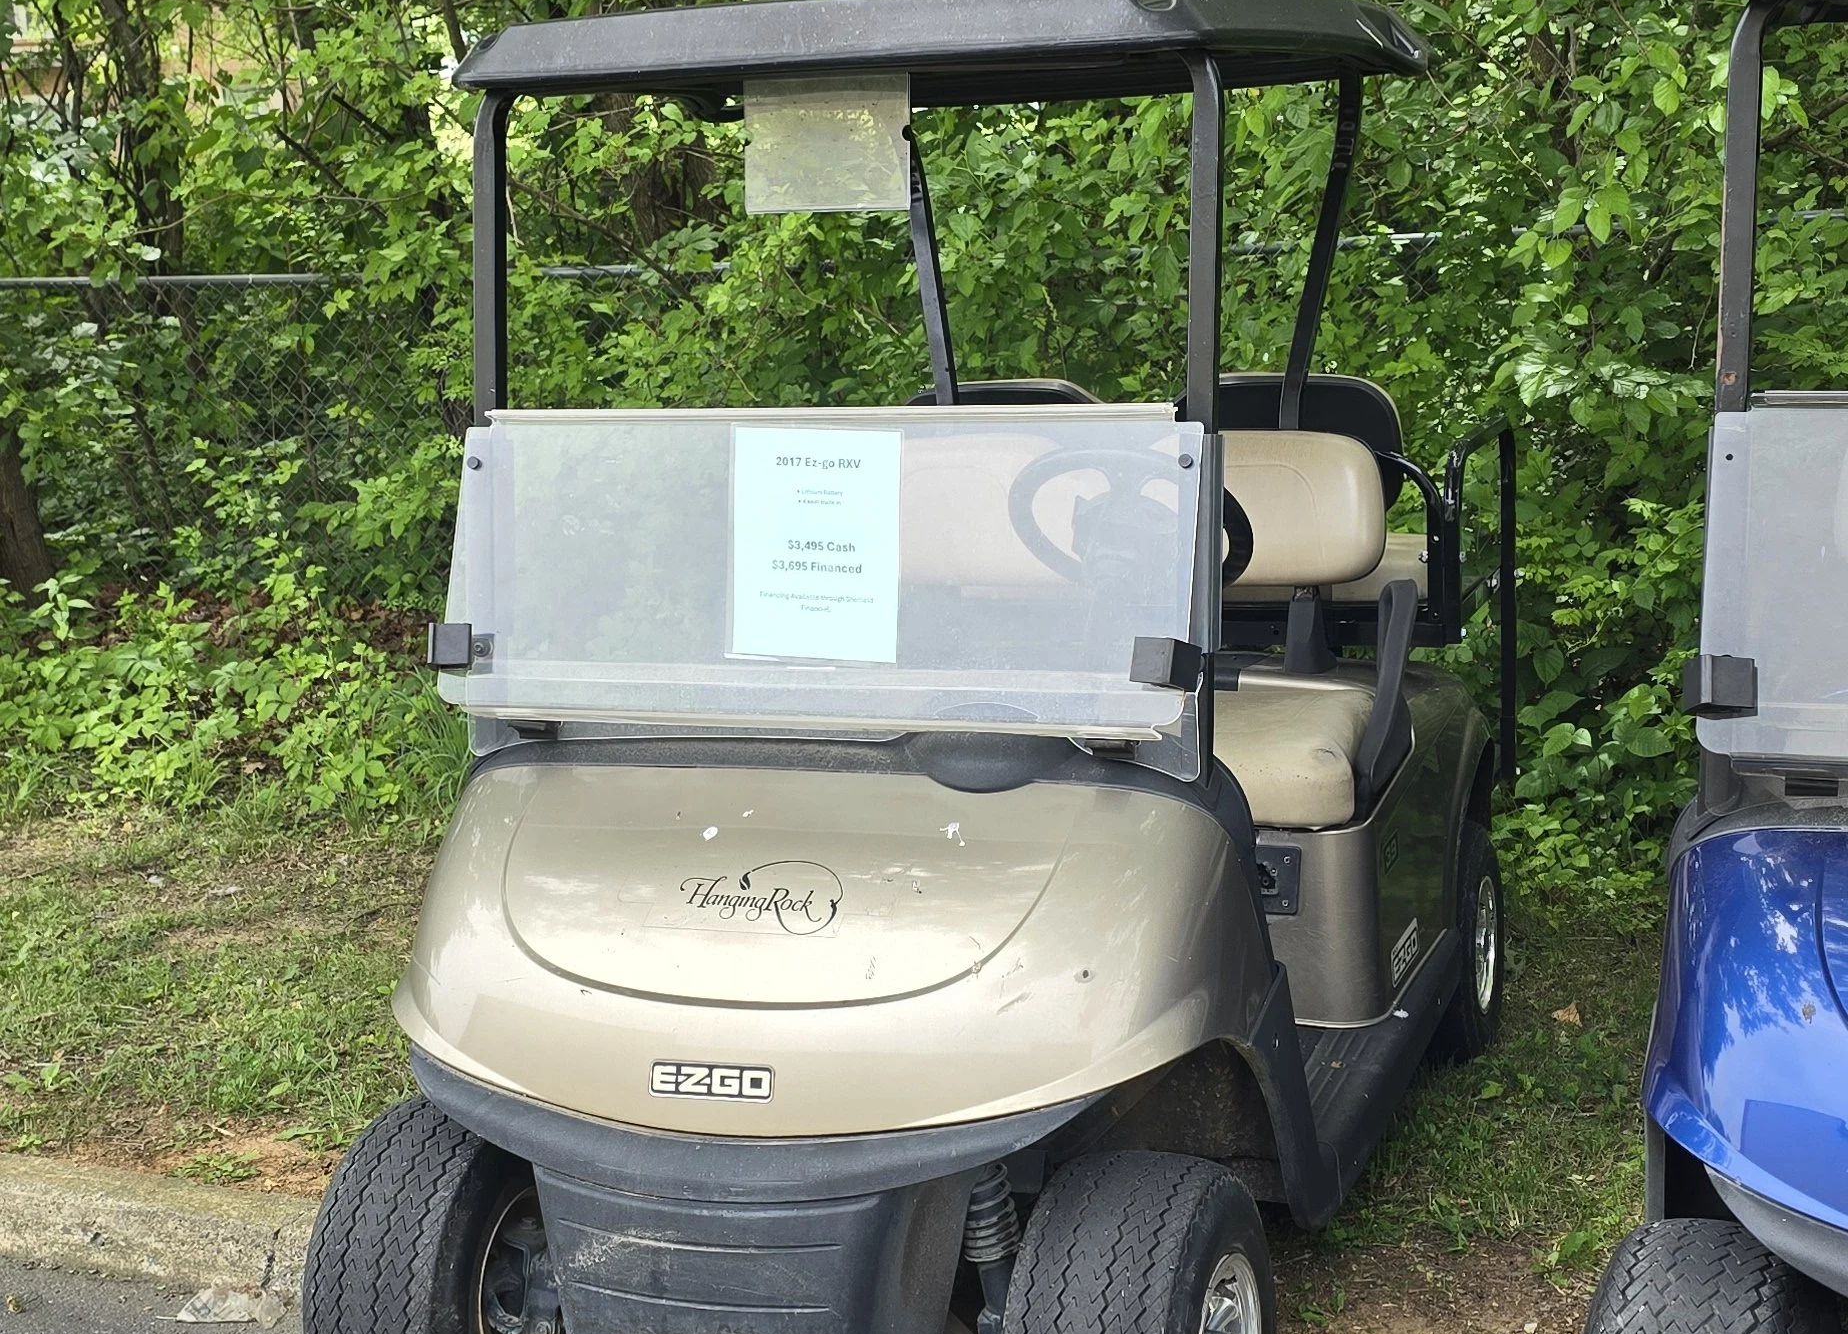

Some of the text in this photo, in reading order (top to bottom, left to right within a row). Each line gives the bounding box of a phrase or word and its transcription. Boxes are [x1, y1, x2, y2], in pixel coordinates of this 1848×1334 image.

[776, 456, 861, 470] 2017 Ez-go RXV
[788, 539, 856, 553] $3,495 Cash
[772, 559, 862, 574] $3,695 Financed
